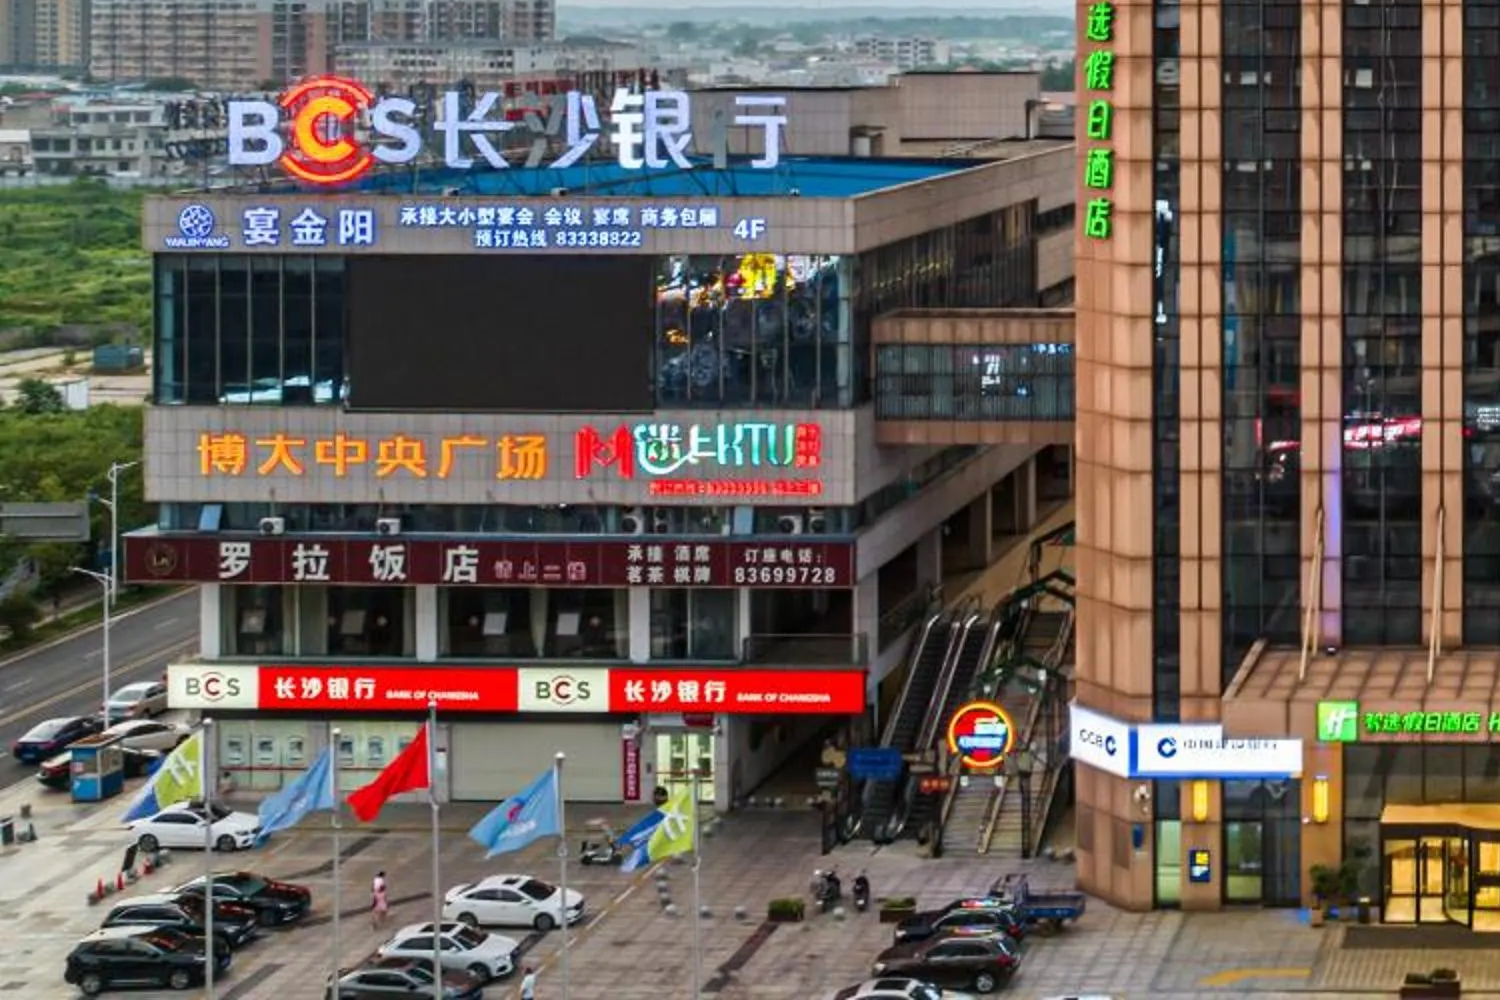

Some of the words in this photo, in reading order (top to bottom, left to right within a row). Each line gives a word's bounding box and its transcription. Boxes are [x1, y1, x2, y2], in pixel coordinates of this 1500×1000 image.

[228, 96, 419, 167] BCS
[433, 87, 787, 169] 长沙银行
[243, 207, 374, 244] 宴金阳
[543, 207, 582, 226] 会议
[475, 229, 548, 247] 预订热线
[556, 230, 642, 247] 83338822
[733, 219, 765, 240] 4F
[197, 433, 548, 481] 博大中央广场
[218, 542, 479, 583] 罗拉饭店
[735, 567, 836, 584] 83699728
[185, 675, 241, 697] BCS
[274, 677, 376, 699] 长沙银行
[535, 680, 591, 700] BCS
[624, 680, 726, 702] 长沙银行
